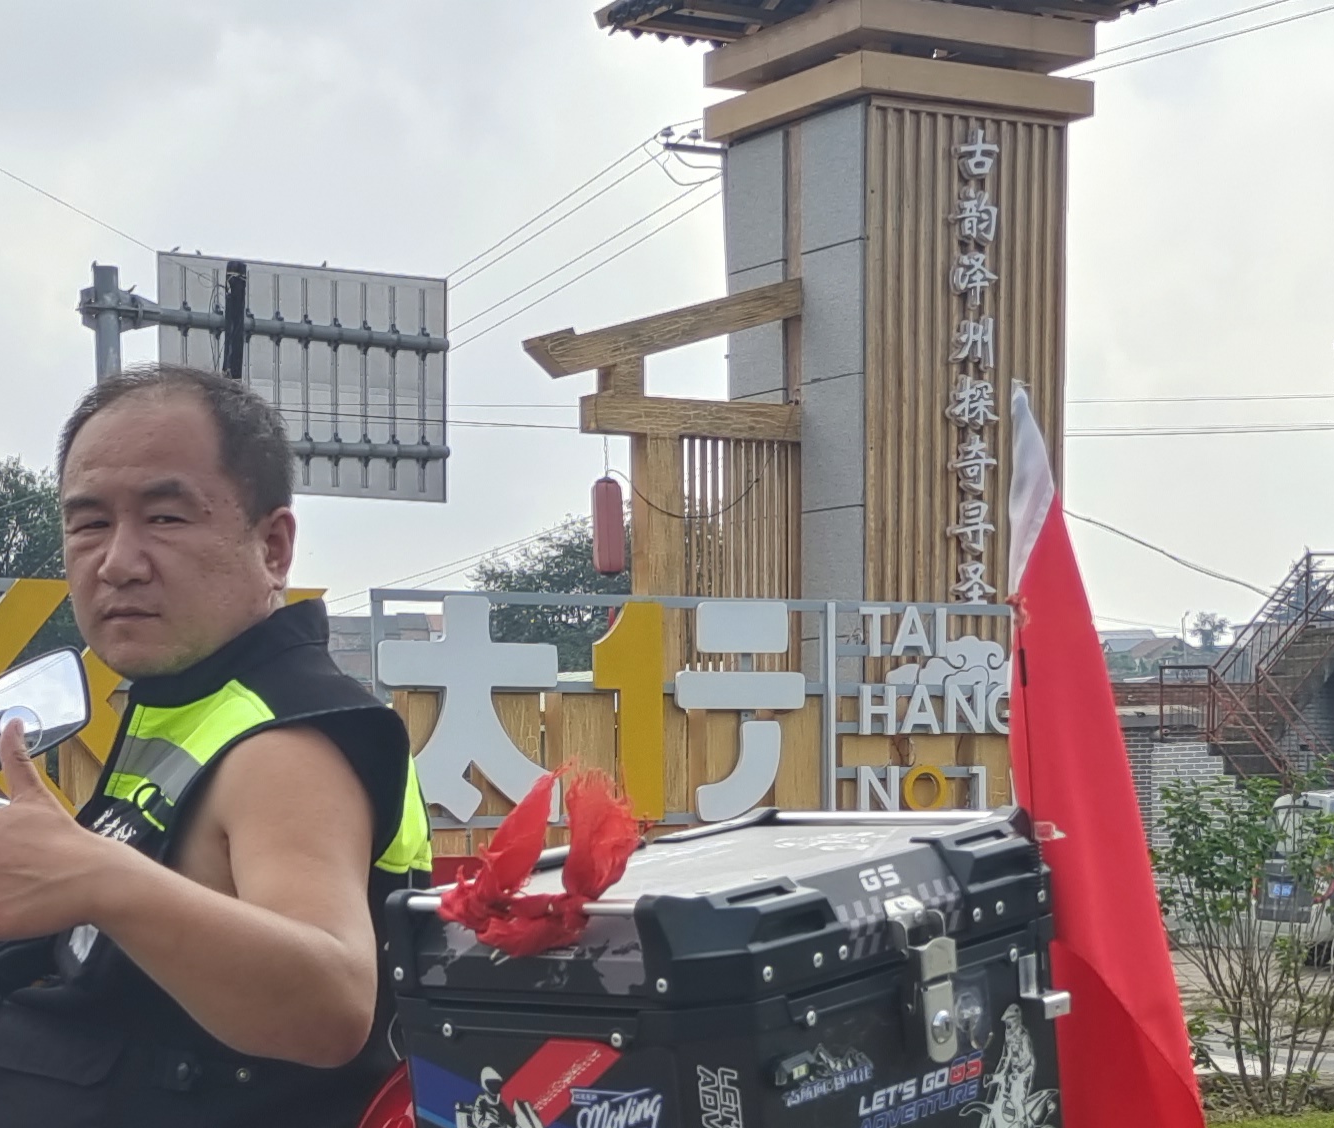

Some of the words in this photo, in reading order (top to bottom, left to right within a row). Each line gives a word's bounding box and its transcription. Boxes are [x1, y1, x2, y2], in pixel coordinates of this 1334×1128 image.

[951, 128, 999, 605] 古韵泽州探奇寻圣
[859, 605, 948, 657] TAI
[859, 863, 900, 892] GS
[858, 1077, 917, 1117] LET'S
